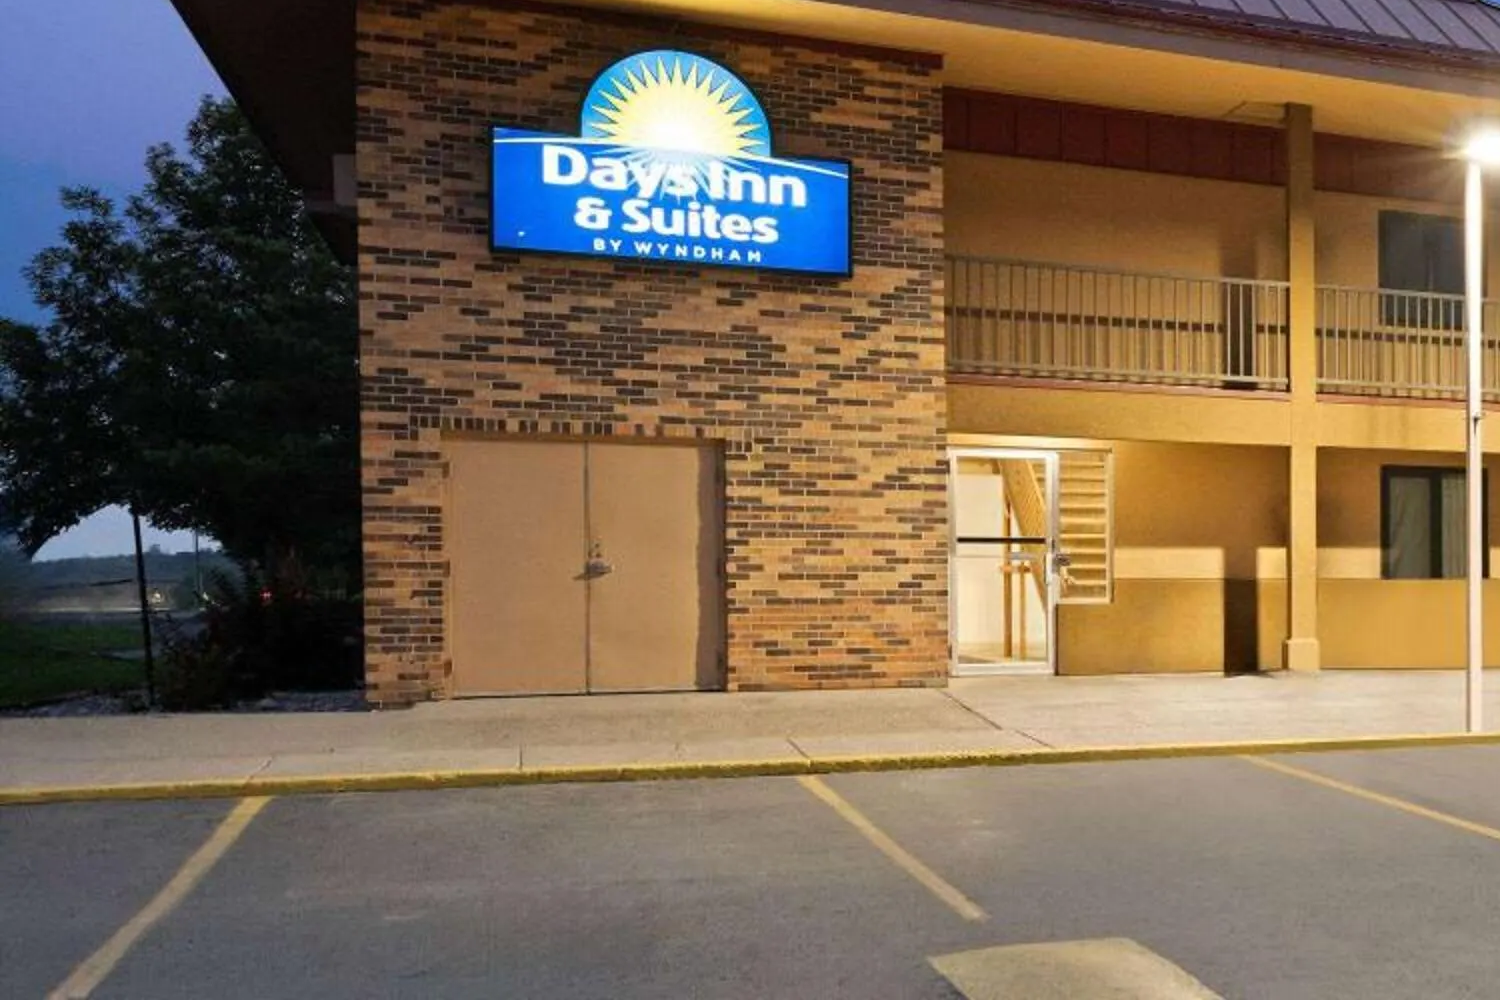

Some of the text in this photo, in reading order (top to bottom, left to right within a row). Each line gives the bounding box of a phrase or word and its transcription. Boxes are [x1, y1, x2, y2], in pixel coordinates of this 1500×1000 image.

[542, 144, 807, 207] Days Inn
[574, 197, 780, 244] & Suites
[593, 238, 762, 263] BY WYNDHAM
